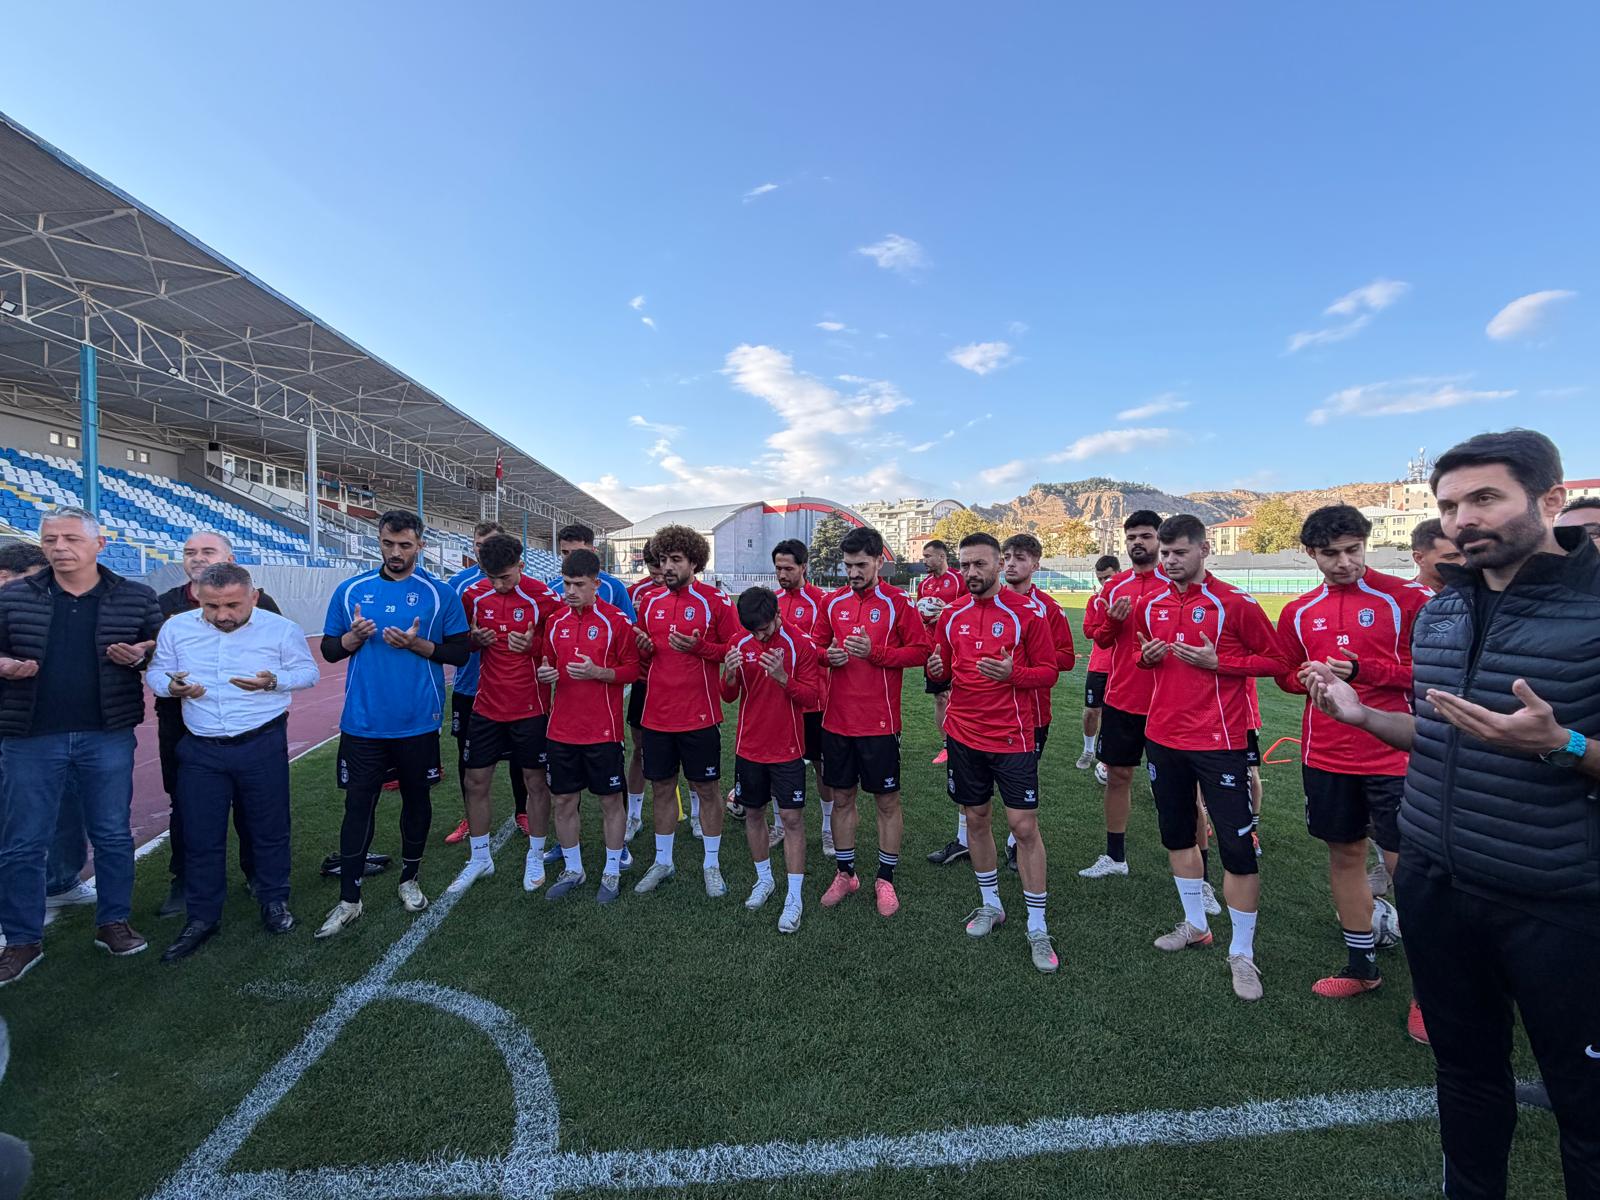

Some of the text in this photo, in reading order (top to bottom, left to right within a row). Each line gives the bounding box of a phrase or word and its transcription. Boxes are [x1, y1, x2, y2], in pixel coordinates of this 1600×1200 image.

[670, 624, 676, 633] 21
[1176, 632, 1185, 642] 10
[1337, 635, 1349, 645] 28
